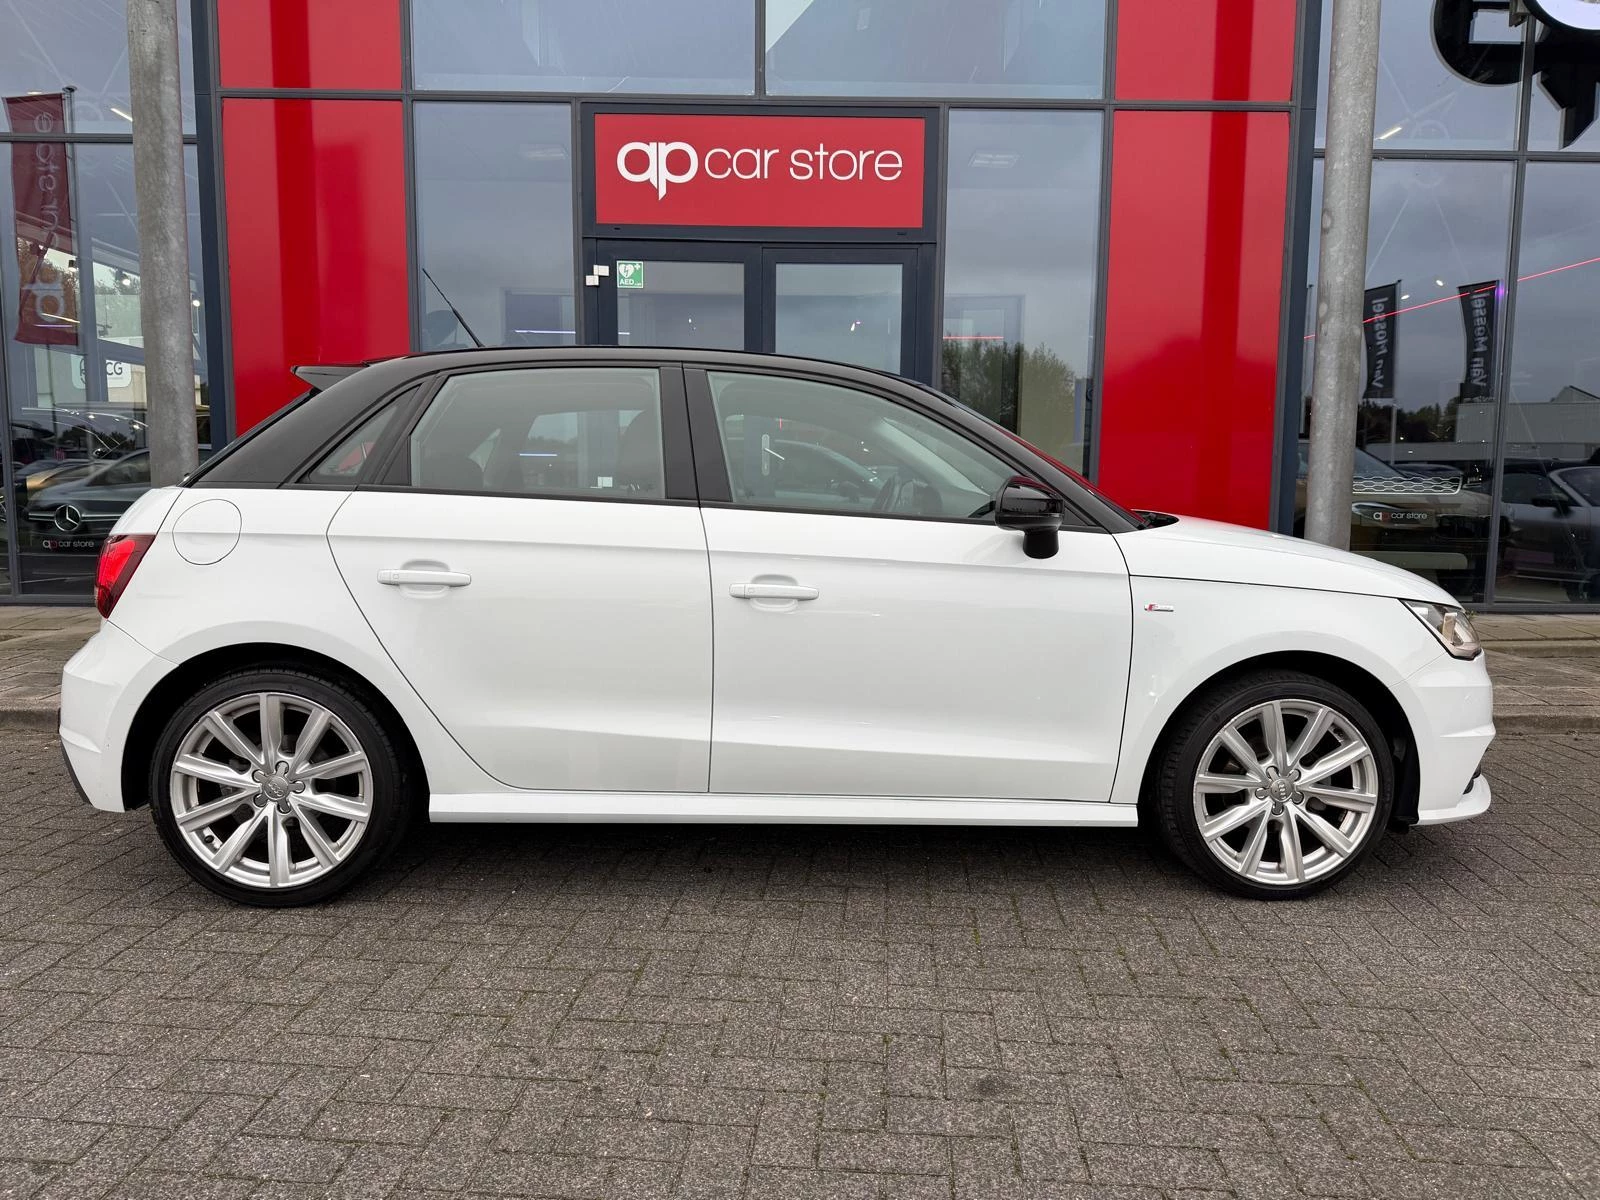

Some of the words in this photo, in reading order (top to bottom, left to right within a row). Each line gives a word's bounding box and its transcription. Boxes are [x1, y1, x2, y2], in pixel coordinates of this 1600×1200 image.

[617, 142, 698, 200] ap
[704, 148, 779, 179] car
[789, 143, 903, 181] store
[72, 540, 95, 548] store
